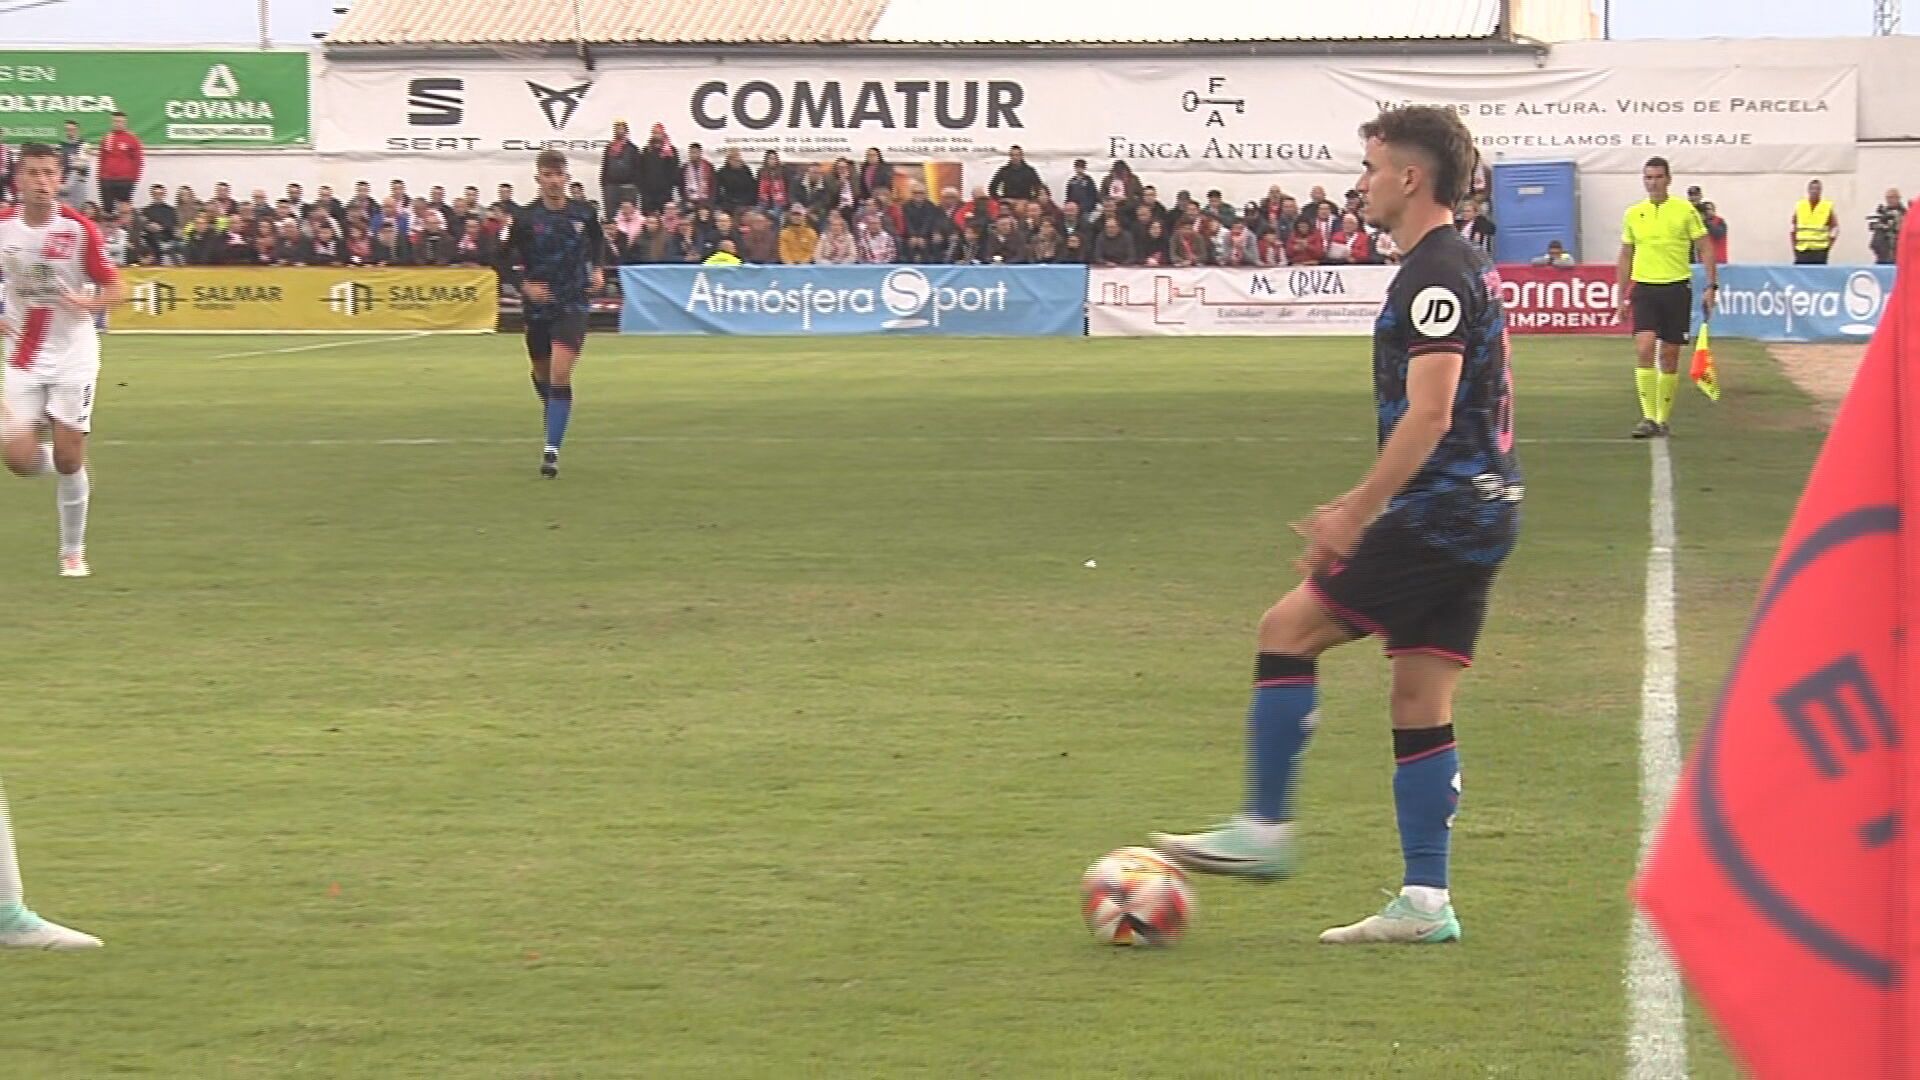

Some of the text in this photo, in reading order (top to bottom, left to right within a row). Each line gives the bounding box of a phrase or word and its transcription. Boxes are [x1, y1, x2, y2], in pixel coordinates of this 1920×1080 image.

[17, 66, 56, 81] EN
[690, 80, 1025, 130] COMATUR
[1479, 103, 1505, 116] DE
[1693, 101, 1721, 113] DE
[1730, 98, 1829, 113] PARCELA
[386, 137, 481, 150] SEAT
[1631, 134, 1656, 146] EL
[1666, 133, 1752, 146] PAISAJE
[192, 285, 283, 301] SALMAR
[387, 285, 479, 301] SALMAR
[687, 267, 1007, 330] Atmósfera Sport
[1419, 300, 1455, 325] JD
